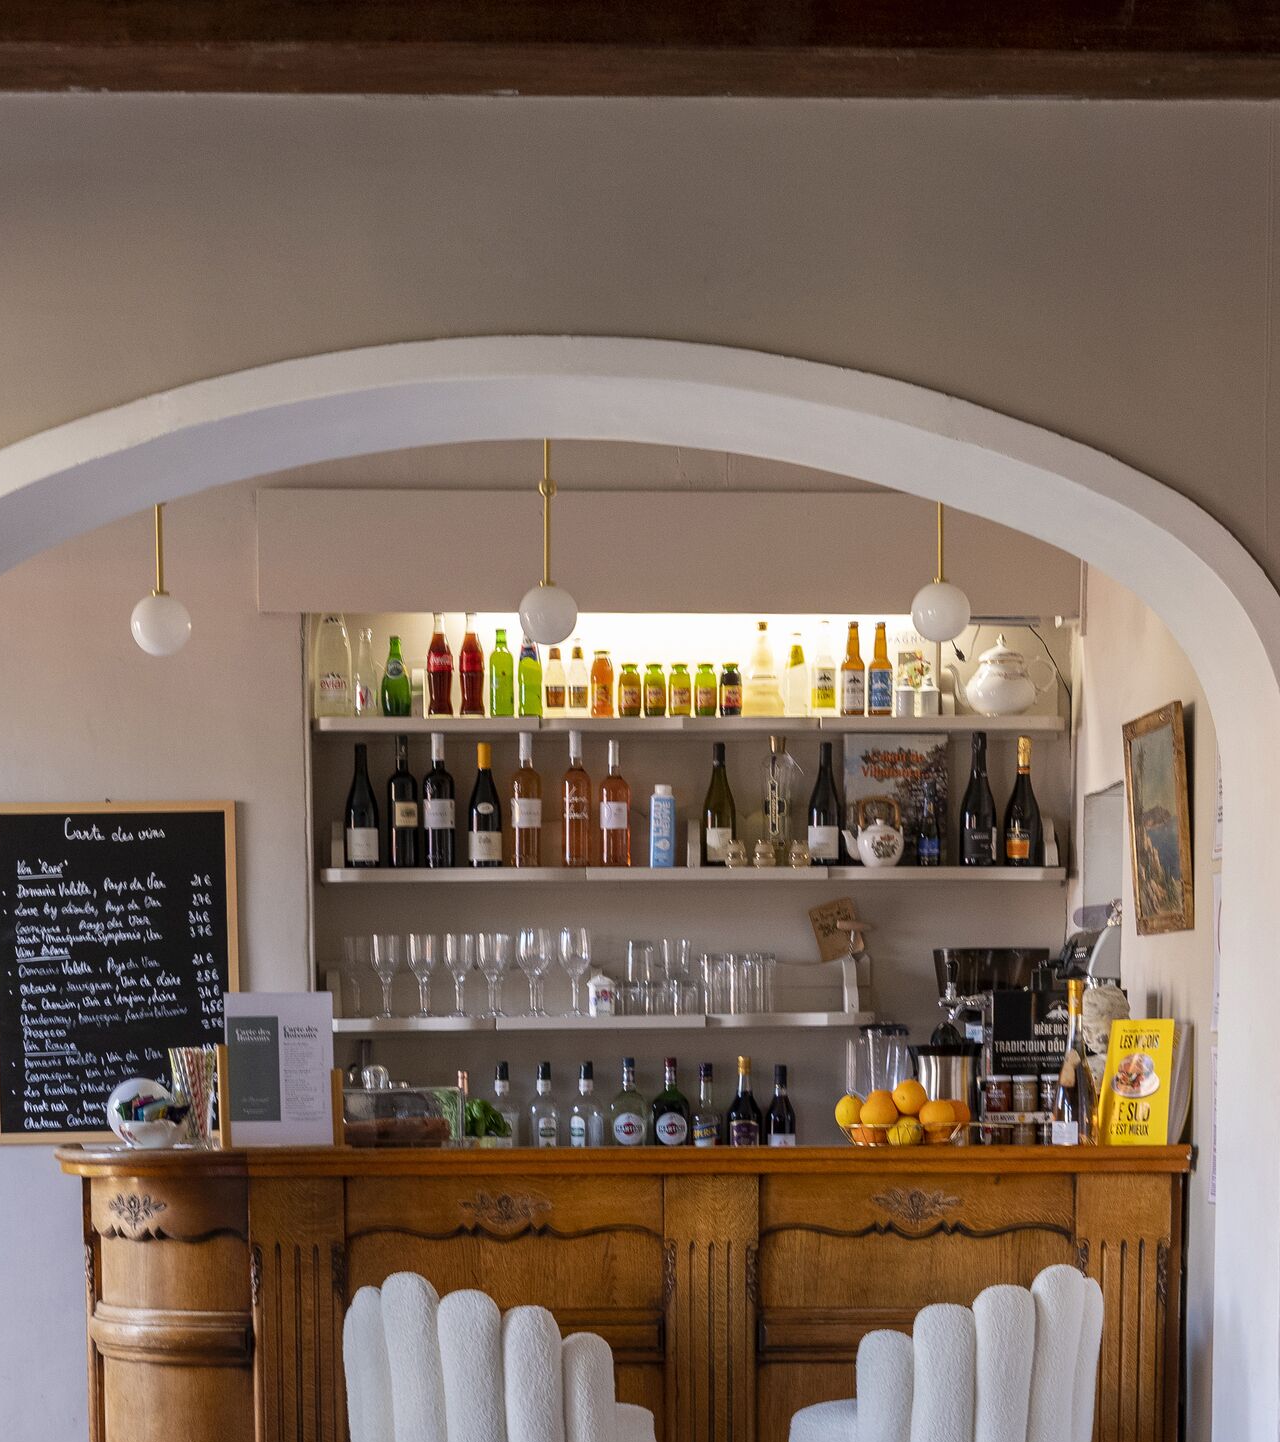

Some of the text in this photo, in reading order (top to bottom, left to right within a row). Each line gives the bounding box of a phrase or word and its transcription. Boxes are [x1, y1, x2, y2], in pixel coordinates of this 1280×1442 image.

[64, 817, 166, 842] Carte des vins
[1034, 1020, 1052, 1036] BIÈRE
[1133, 1034, 1160, 1050] NÇOIS
